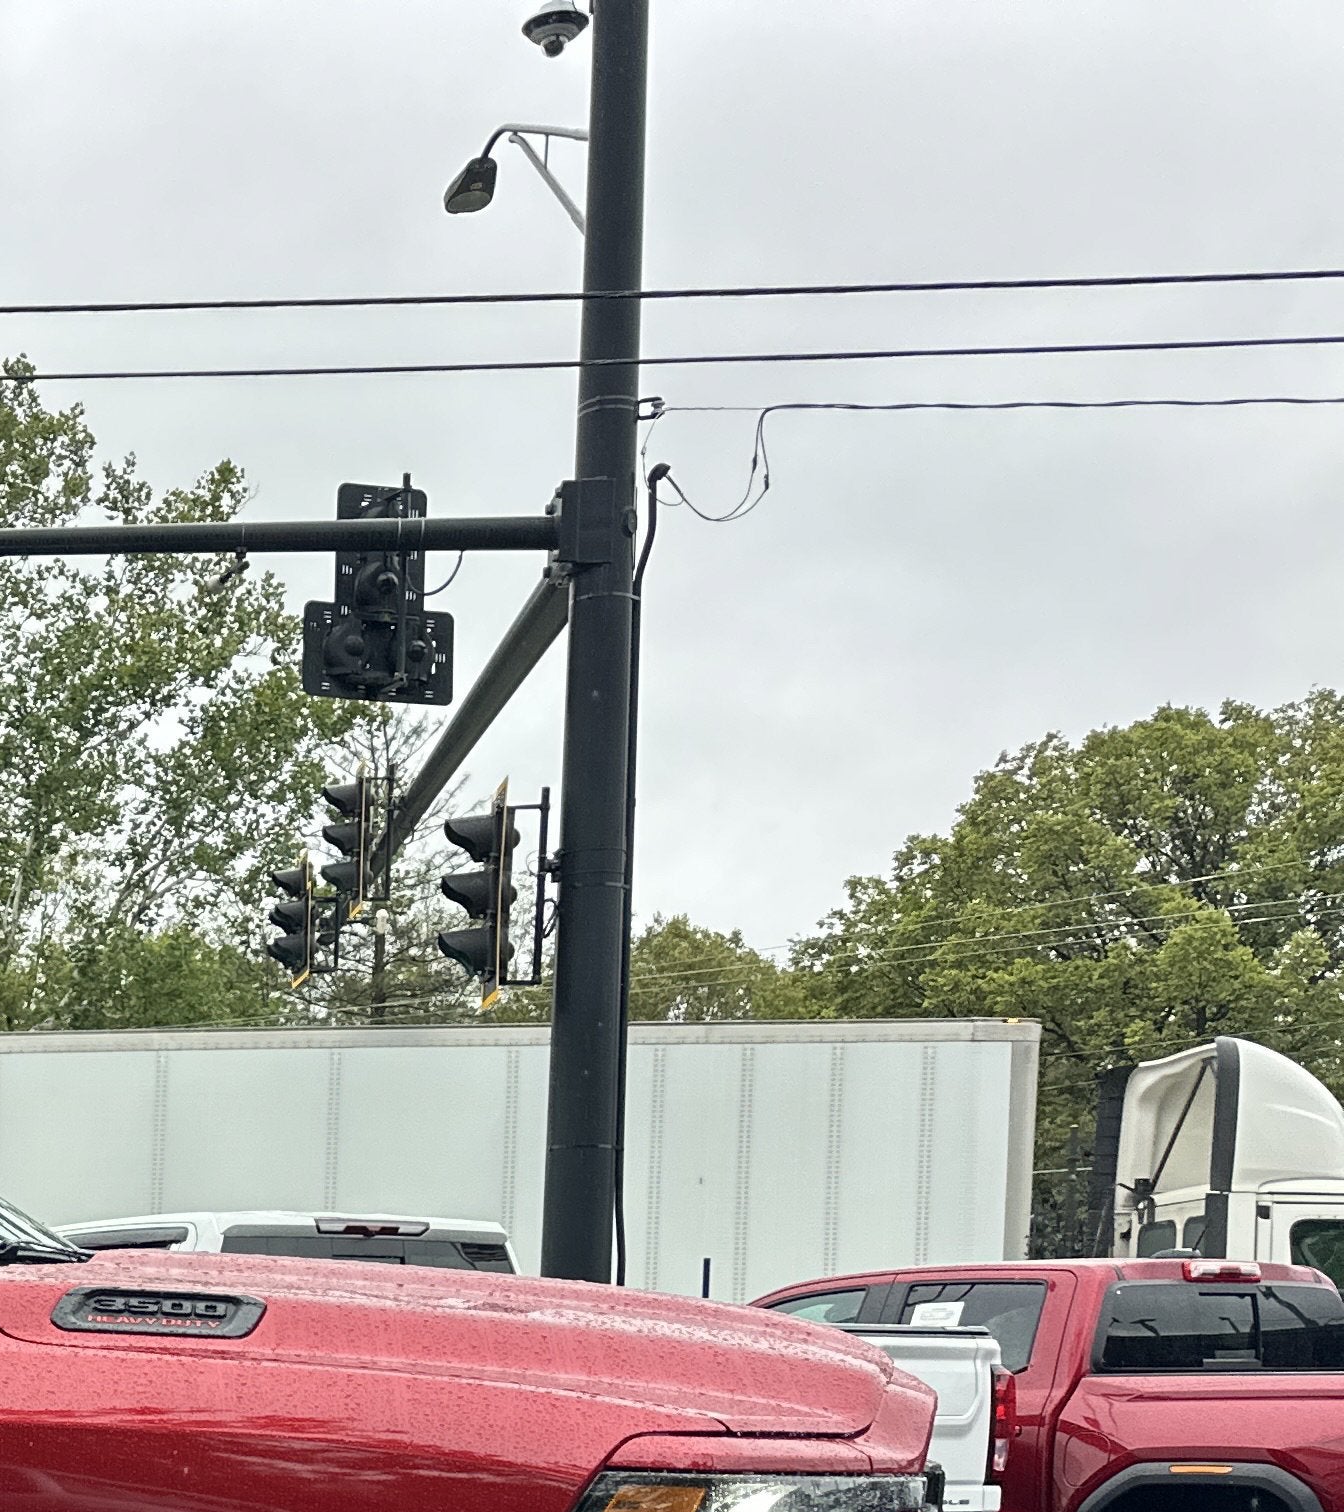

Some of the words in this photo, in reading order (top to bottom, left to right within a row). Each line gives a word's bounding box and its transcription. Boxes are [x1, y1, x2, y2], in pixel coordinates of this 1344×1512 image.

[92, 1296, 228, 1319] 3500
[87, 1314, 160, 1326] HEAVY
[161, 1317, 221, 1329] DUTY
